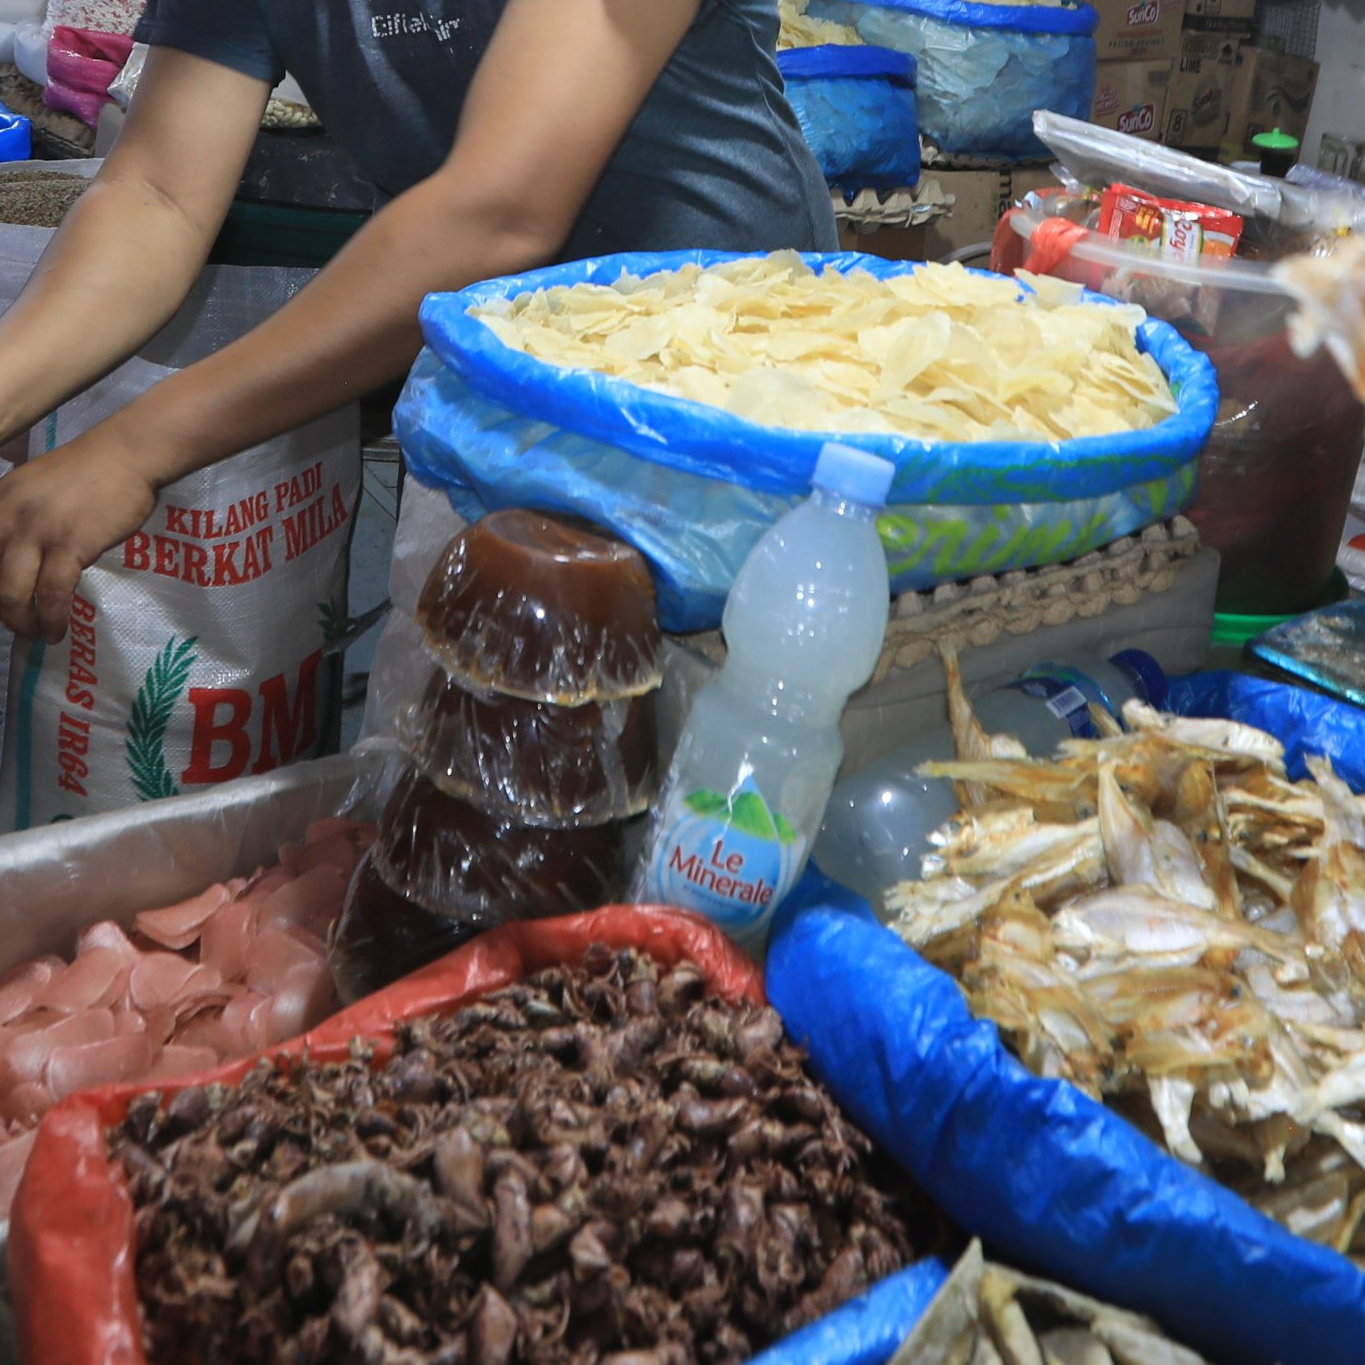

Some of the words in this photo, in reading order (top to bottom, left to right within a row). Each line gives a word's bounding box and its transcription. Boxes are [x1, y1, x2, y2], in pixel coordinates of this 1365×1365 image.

[1127, 2, 1159, 25] SunCo
[1180, 56, 1202, 74] LIME
[1117, 105, 1154, 132] SunCo
[122, 526, 275, 588] BERKAT
[283, 482, 349, 563] MILA
[165, 490, 269, 541] KILANG
[274, 461, 324, 514] PADI
[65, 592, 98, 712] BERAS
[181, 649, 324, 786] BM
[57, 710, 92, 797] IR64
[668, 845, 776, 906] Minerale
[710, 839, 744, 874] Le
